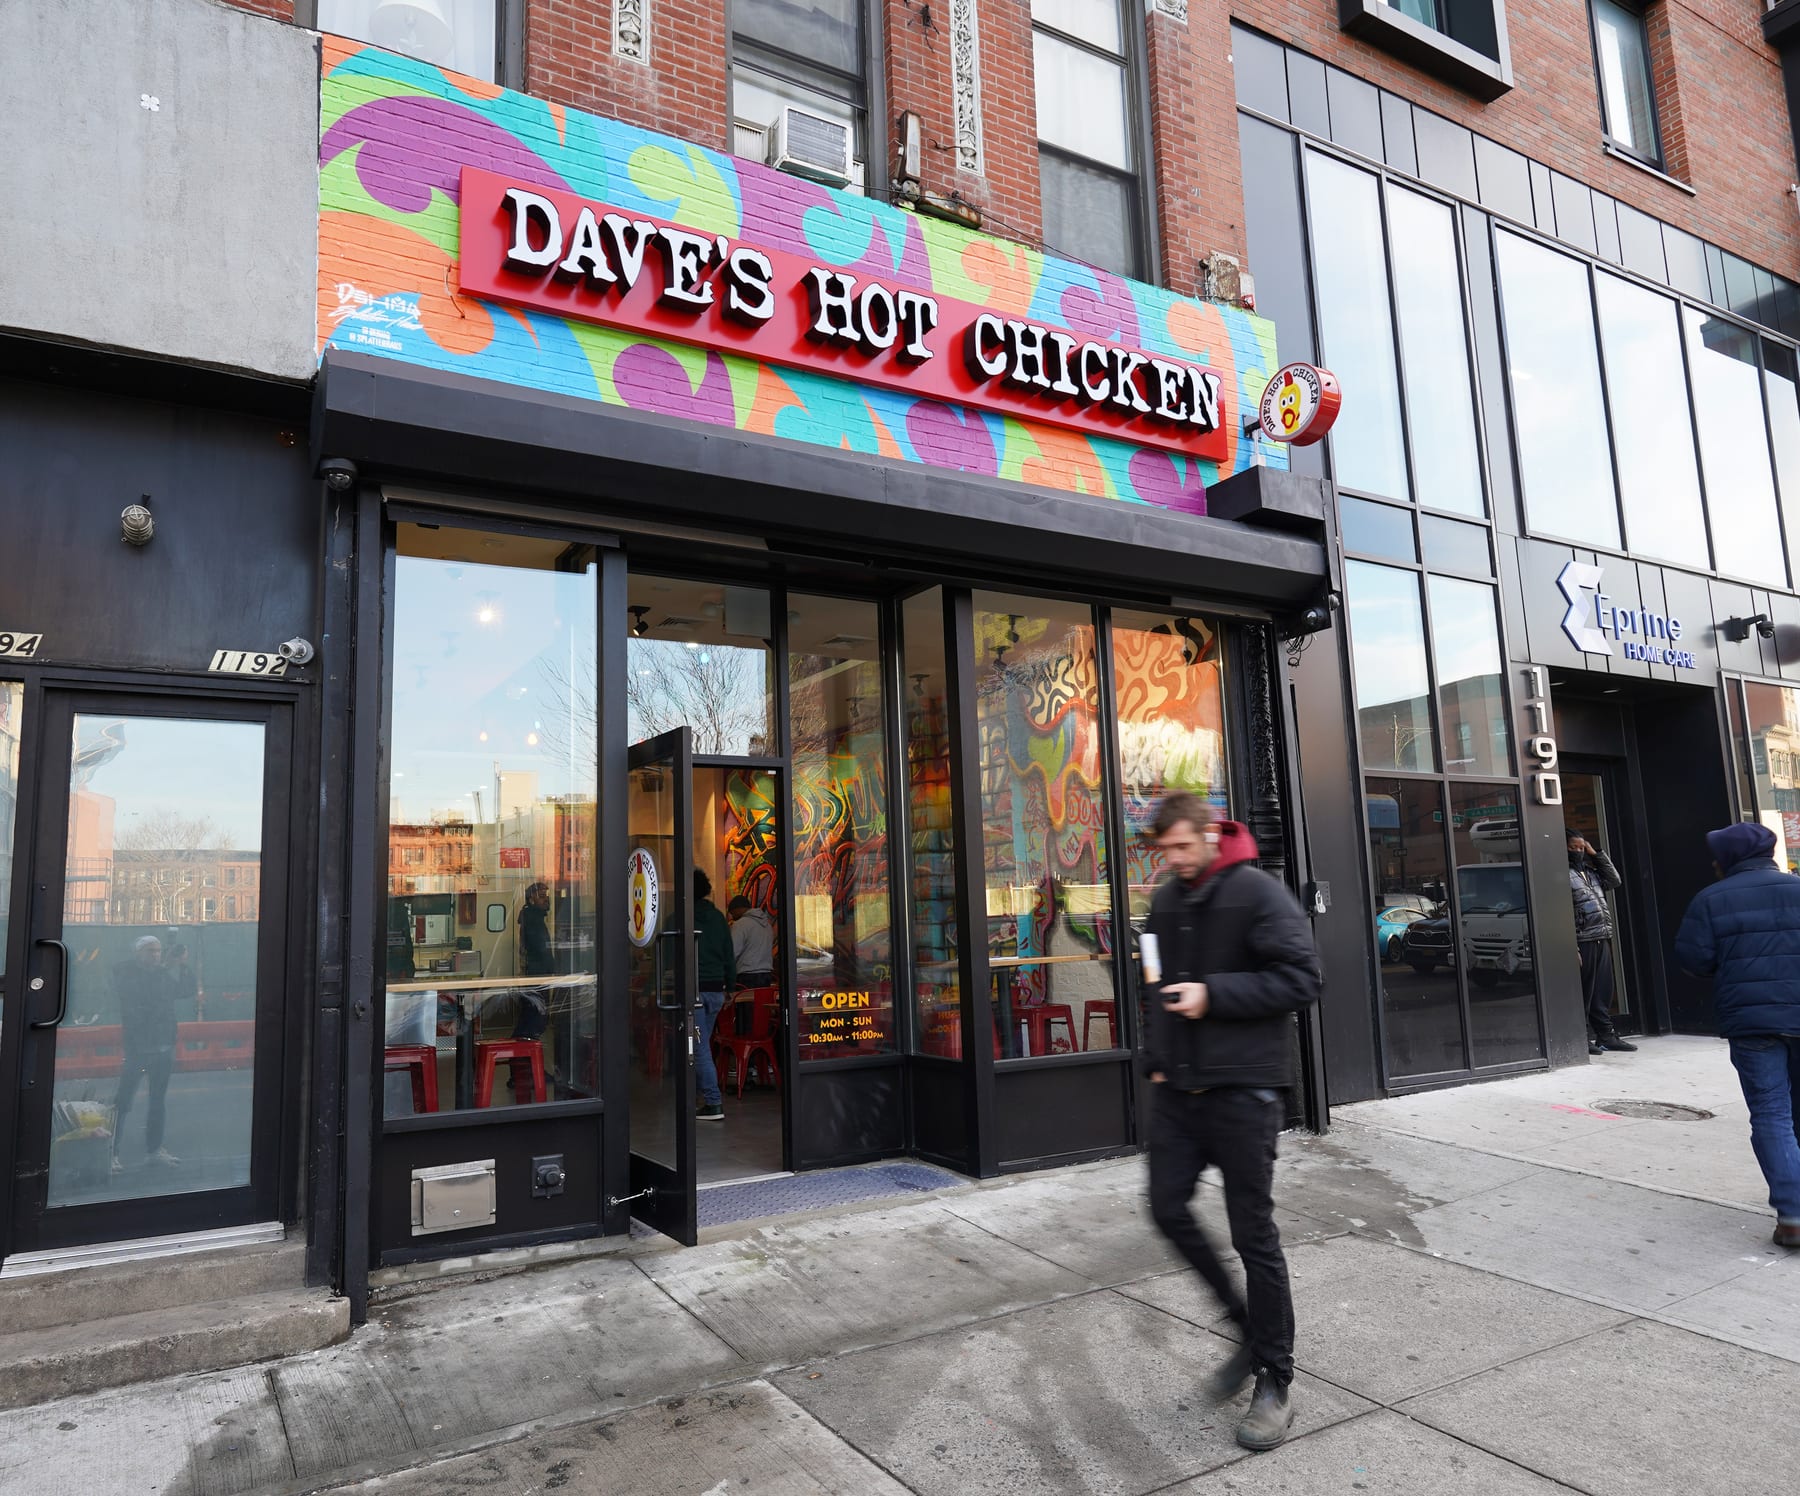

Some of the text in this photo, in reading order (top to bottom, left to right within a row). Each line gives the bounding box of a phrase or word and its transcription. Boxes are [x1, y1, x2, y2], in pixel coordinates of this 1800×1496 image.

[503, 186, 1221, 431] DAVE'S HOT CHICKEN
[1262, 367, 1319, 433] DAVE'S HOT CHICKEN
[1594, 593, 1682, 641] Eprine
[215, 650, 289, 676] 1192
[1624, 641, 1697, 669] HOME CARE
[1530, 666, 1563, 806] 1190
[641, 854, 657, 914] CHICKEN
[821, 991, 870, 1009] OPEN
[808, 1033, 844, 1043] 10:30AM
[851, 1030, 883, 1040] 11:00PM
[820, 1018, 844, 1028] MON
[852, 1016, 872, 1026] SUN
